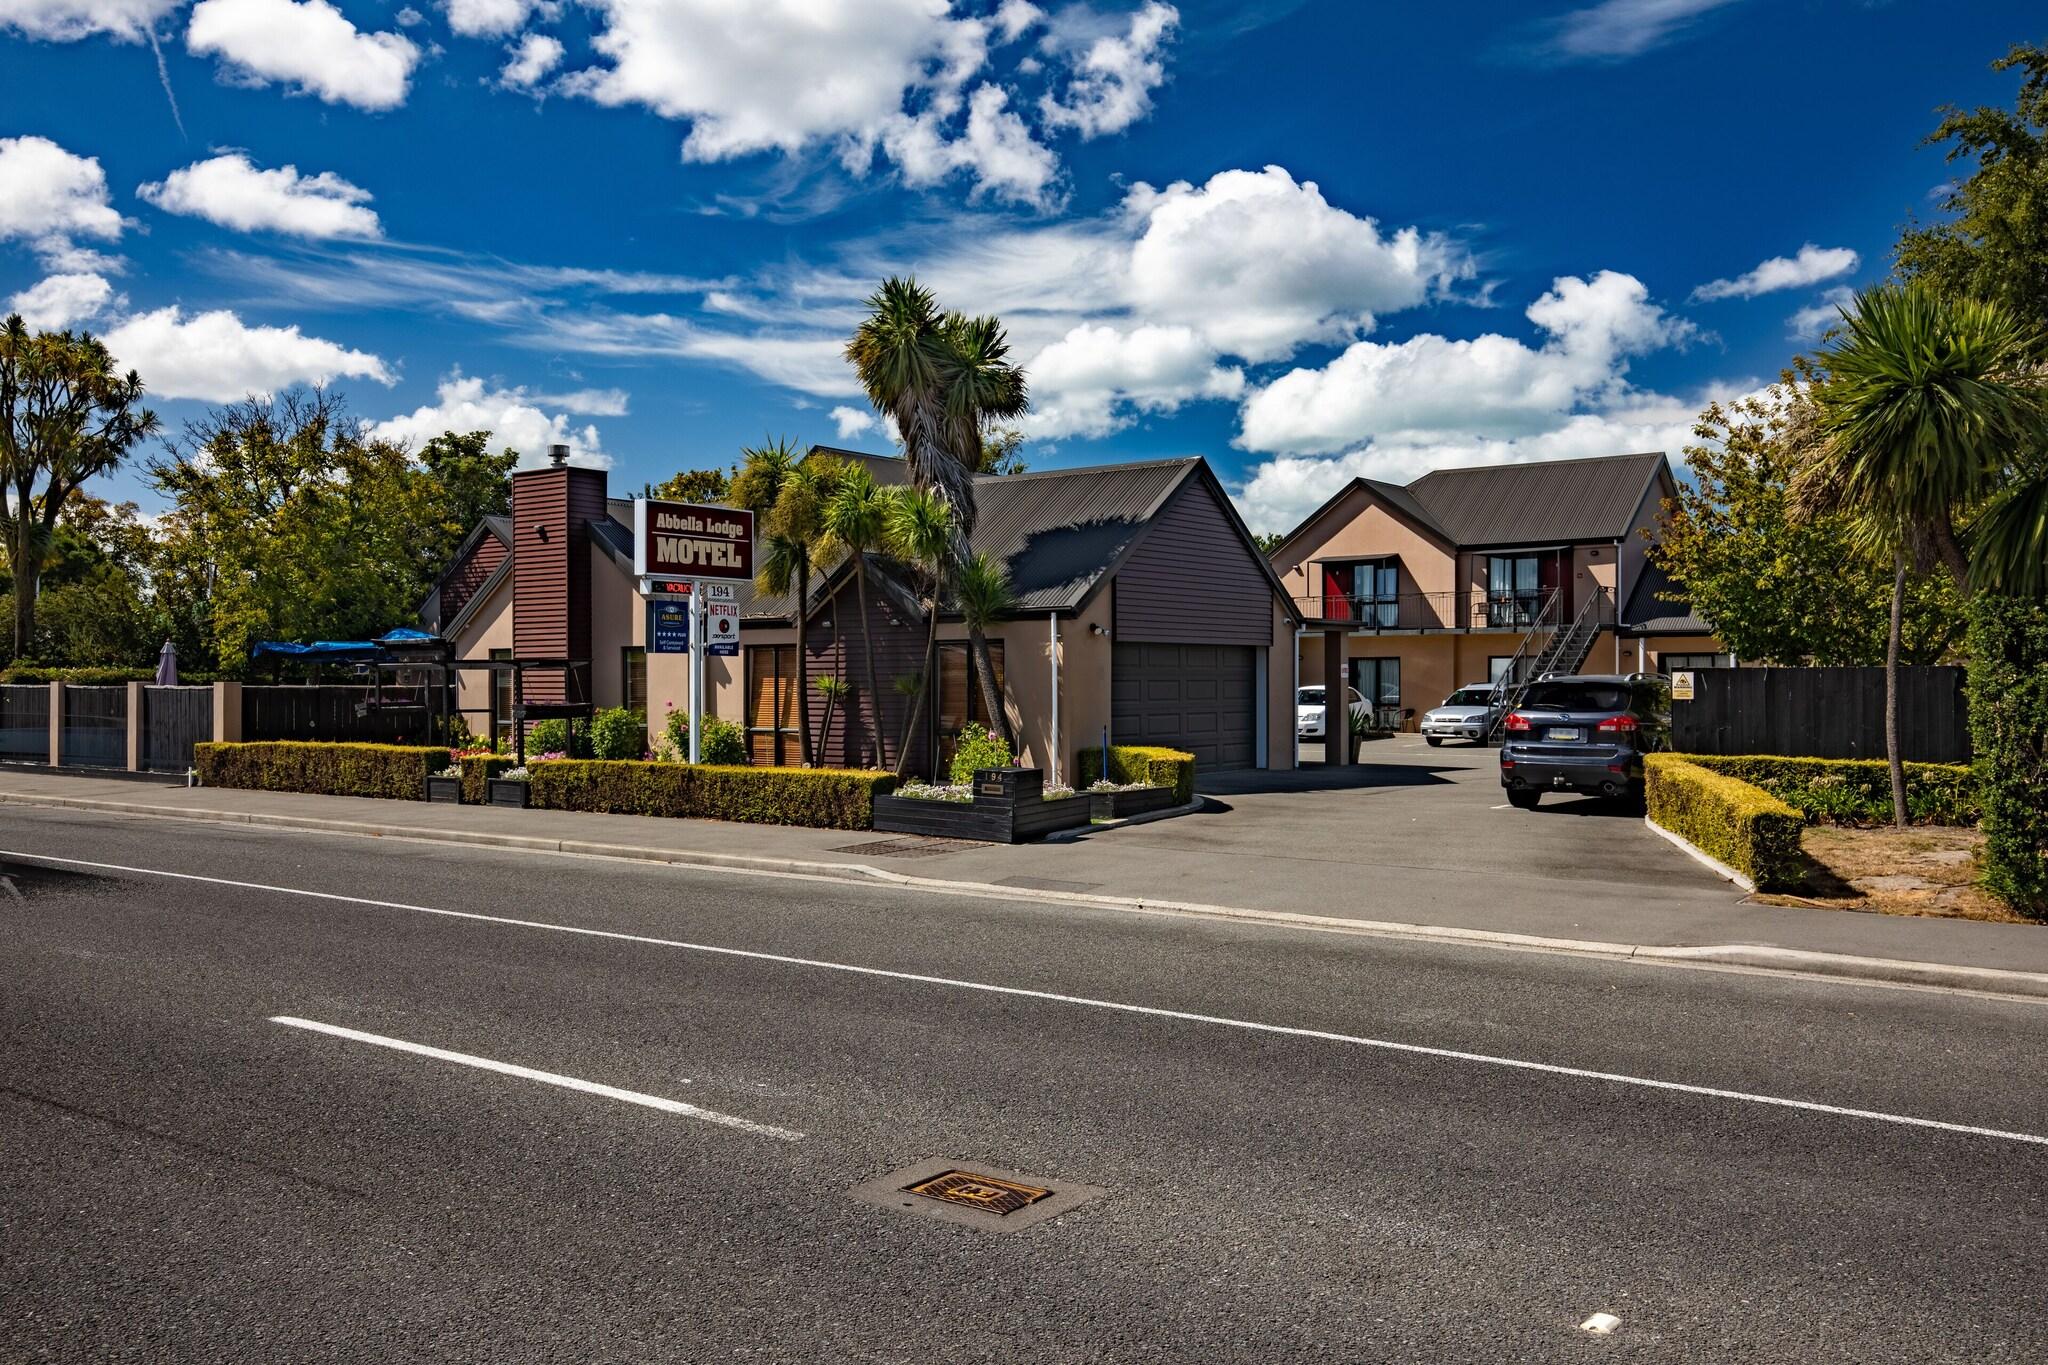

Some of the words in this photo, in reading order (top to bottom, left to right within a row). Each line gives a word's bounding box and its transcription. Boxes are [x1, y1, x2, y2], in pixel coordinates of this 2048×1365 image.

[656, 513, 703, 532] Abbella
[706, 518, 744, 538] Lodge
[656, 536, 742, 568] MOTEL
[711, 585, 730, 597] 194
[661, 614, 683, 622] ASURE
[709, 604, 738, 618] NETFLIX
